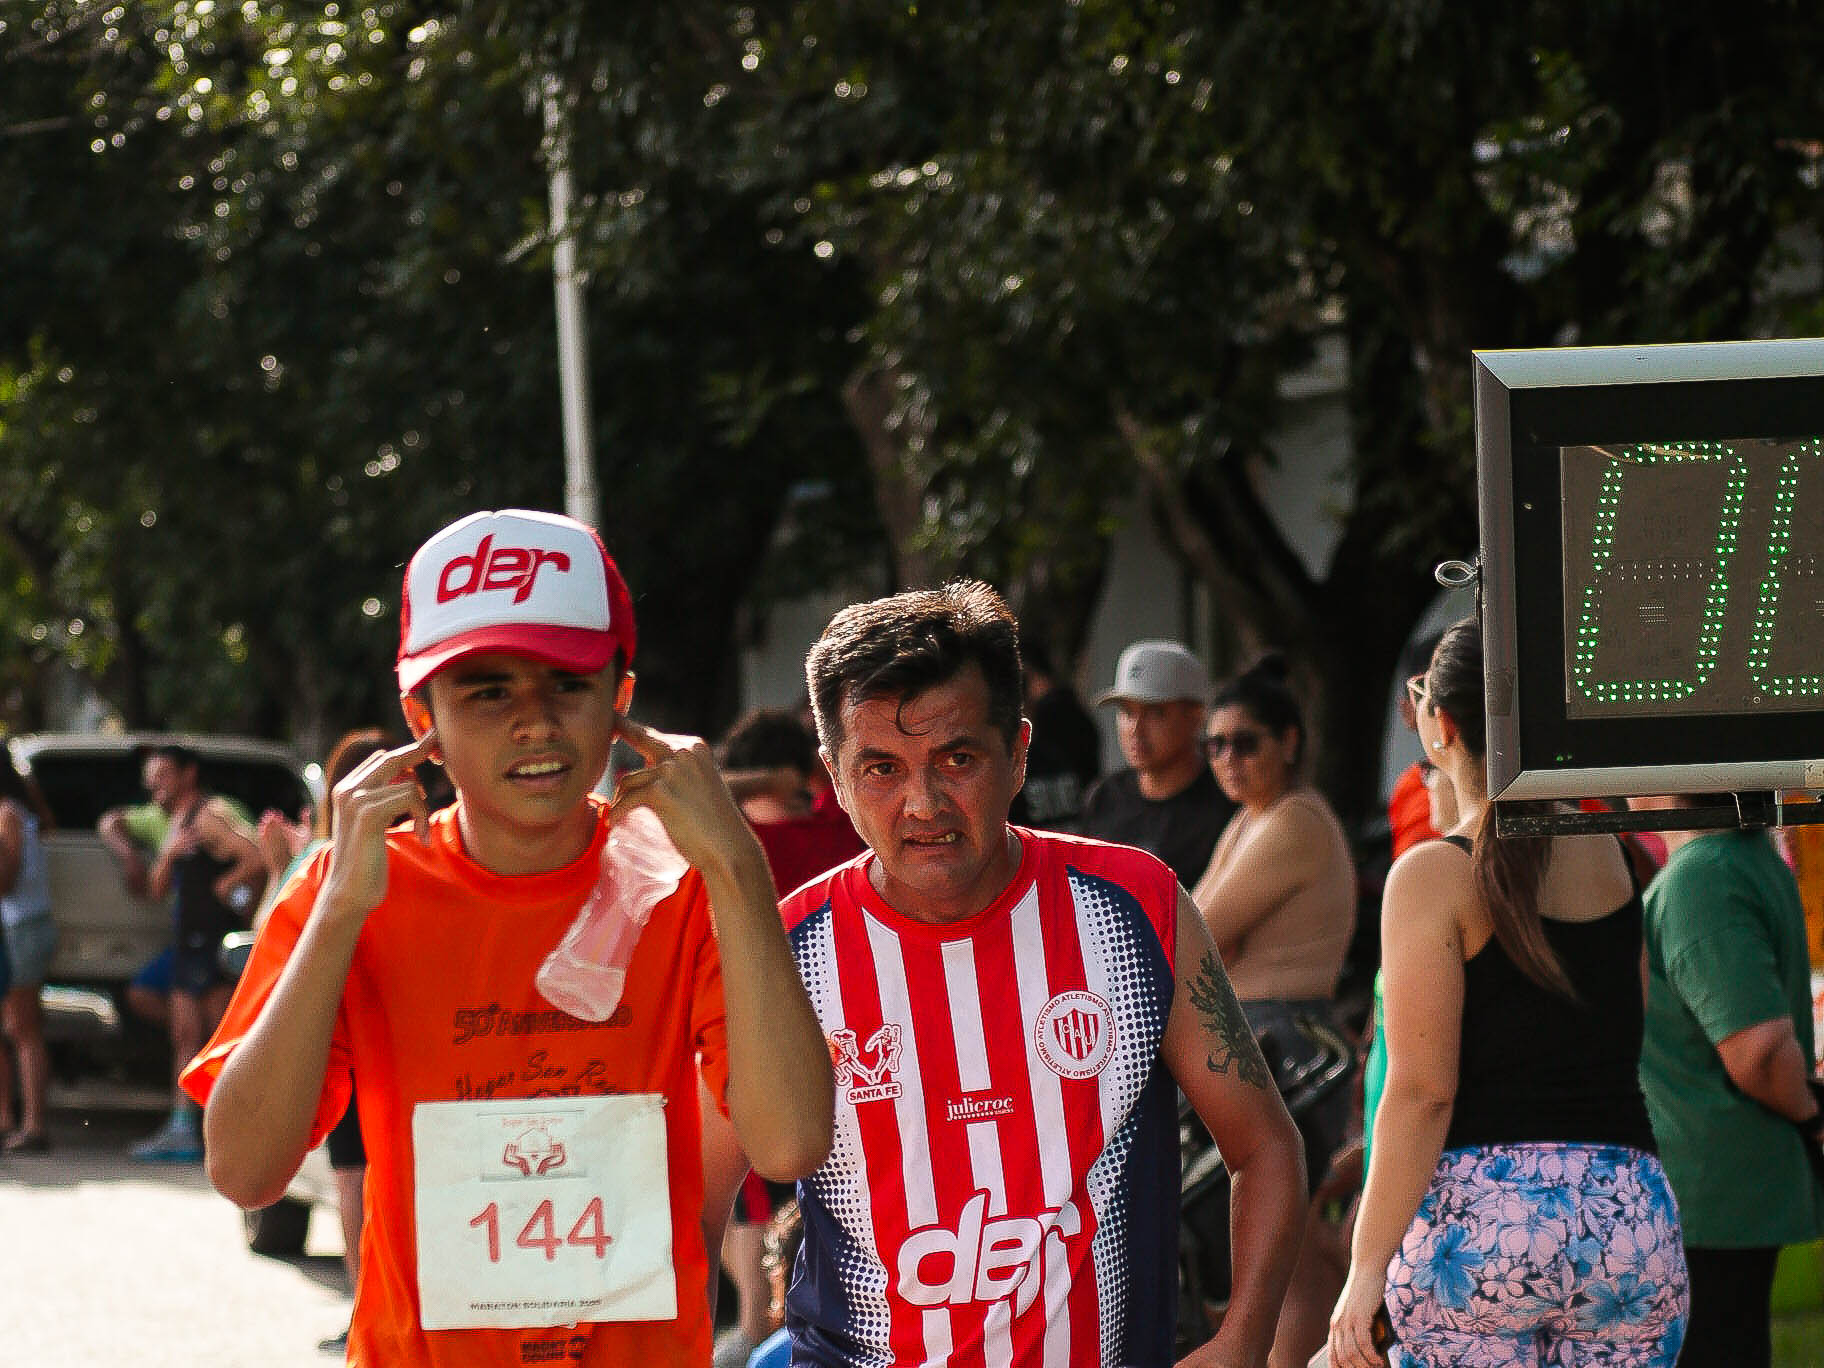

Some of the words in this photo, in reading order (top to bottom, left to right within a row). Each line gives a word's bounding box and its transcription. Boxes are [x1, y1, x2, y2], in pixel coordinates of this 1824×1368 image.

[436, 532, 571, 605] der
[1062, 993, 1104, 1008] ATLETISMO
[849, 1088, 882, 1101] SANTA
[885, 1085, 899, 1096] FE
[946, 1097, 1013, 1122] julicroc
[469, 1196, 614, 1264] 144
[897, 1187, 1081, 1319] der
